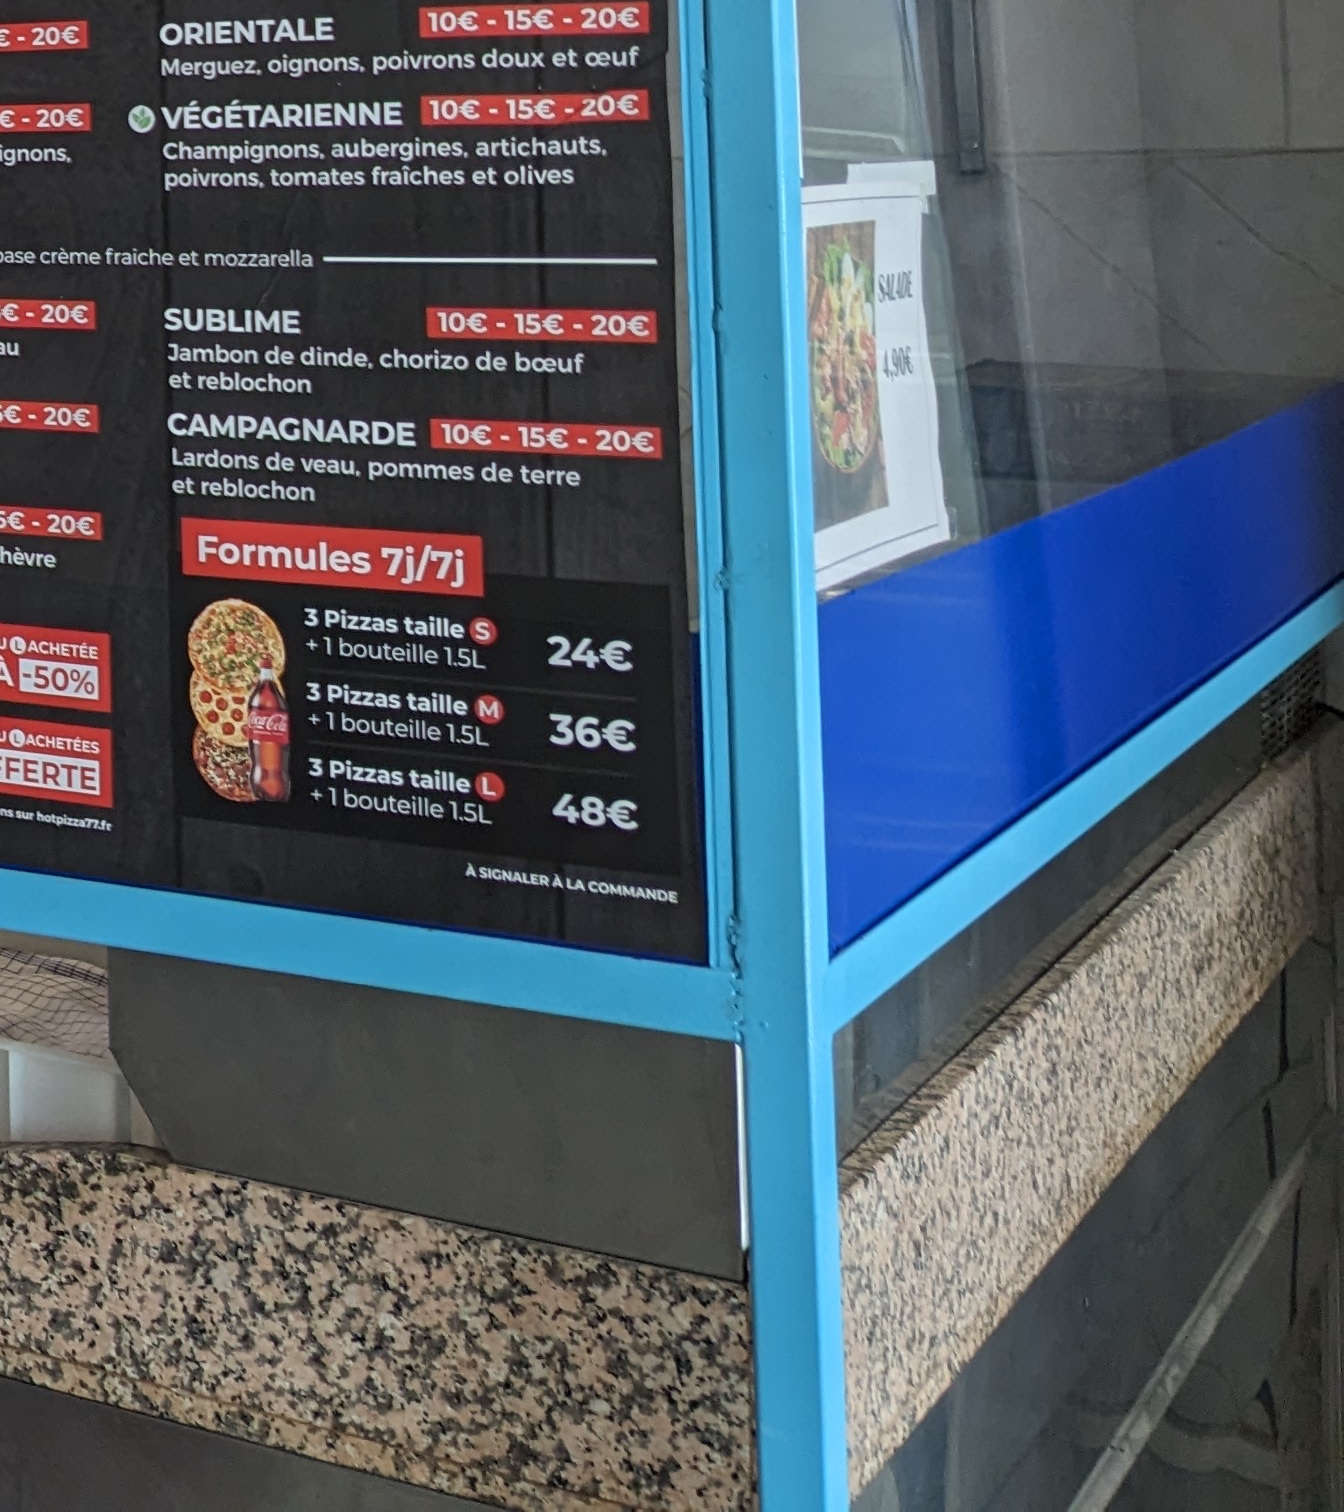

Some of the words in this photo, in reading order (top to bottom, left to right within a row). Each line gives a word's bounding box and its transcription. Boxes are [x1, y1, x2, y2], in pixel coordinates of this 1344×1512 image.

[31, 25, 80, 46] 20€
[159, 17, 335, 47] ORIENTALE
[160, 99, 404, 130] VÉGÉTARIENNE
[162, 140, 325, 164] Champignons,
[331, 136, 469, 162] aubergines,
[475, 135, 607, 157] artichauts,
[39, 247, 102, 265] crème
[178, 250, 200, 267] et
[204, 248, 314, 268] mozzarella
[877, 271, 913, 303] SALADE
[164, 307, 302, 335] SUBLIME
[436, 311, 488, 334] 10€
[513, 313, 564, 335] 15€
[590, 314, 650, 337] 20€
[882, 346, 914, 380] 4,90€
[168, 371, 192, 389] et
[197, 371, 312, 394] reblochon
[167, 412, 417, 447] CAMPAGNARDE
[197, 535, 372, 575] Formules
[380, 544, 465, 588] 7j/7j
[304, 607, 320, 627] 3
[324, 608, 399, 634] Pizzas
[402, 615, 466, 639] taille
[27, 640, 99, 660] ACHETÉE
[323, 636, 332, 656] 1
[338, 636, 439, 665] bouteille
[443, 646, 486, 669] 1.5L
[546, 635, 633, 672] 24€
[21, 664, 96, 695] -50%
[26, 731, 99, 754] ACHETÉES
[549, 713, 637, 752] 36€
[552, 793, 639, 831] 48€
[465, 862, 477, 878] À
[478, 866, 550, 887] SIGNALER
[551, 873, 564, 889] À
[565, 877, 586, 892] LA
[587, 880, 678, 904] COMMANDE
